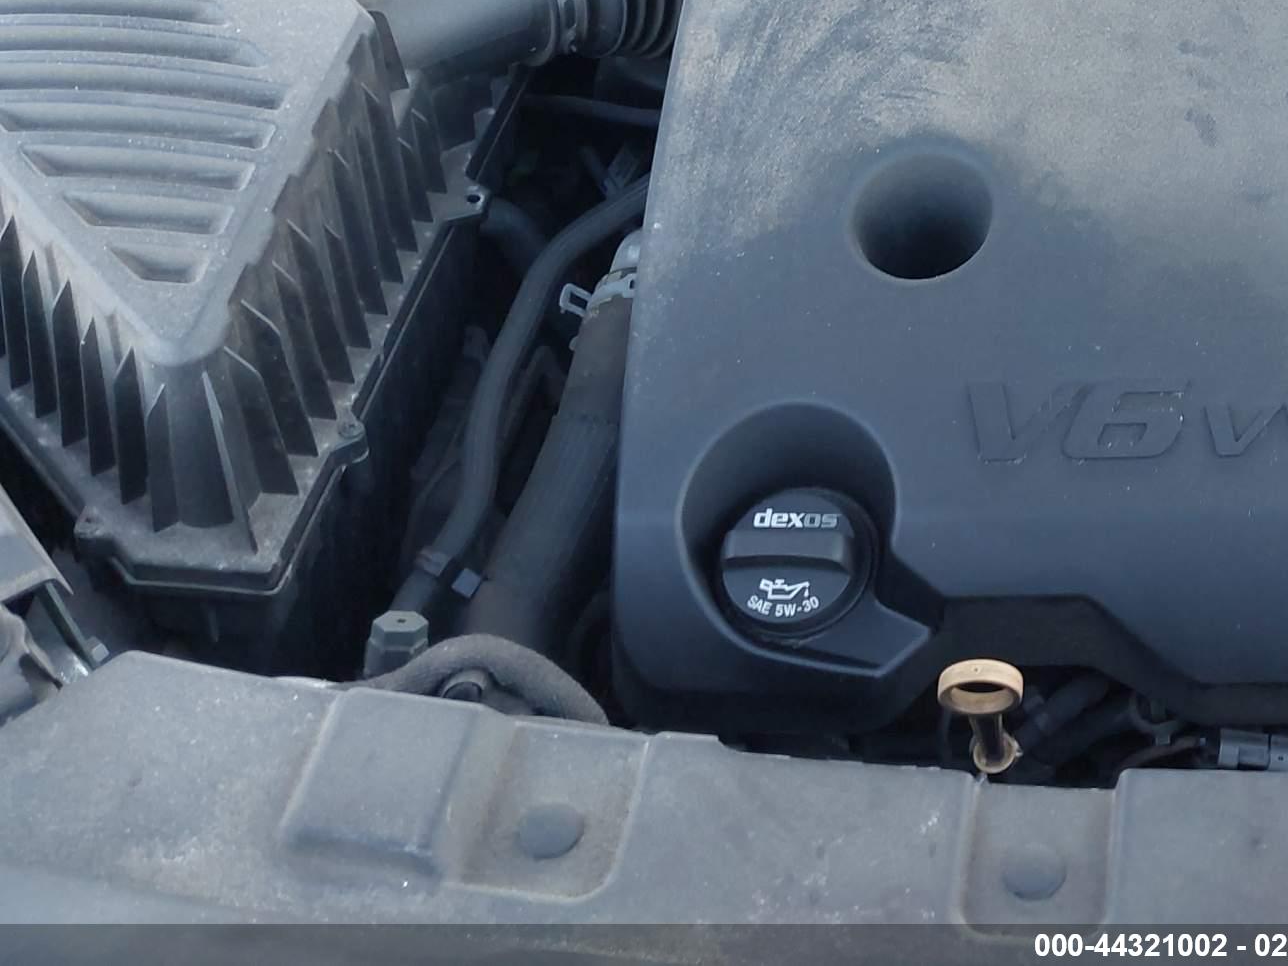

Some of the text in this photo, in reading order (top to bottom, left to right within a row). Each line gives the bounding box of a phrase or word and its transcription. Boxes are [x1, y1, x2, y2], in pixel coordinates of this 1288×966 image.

[965, 380, 1192, 463] V6
[753, 507, 842, 528] dexos
[746, 594, 820, 618] SAE 5W-30
